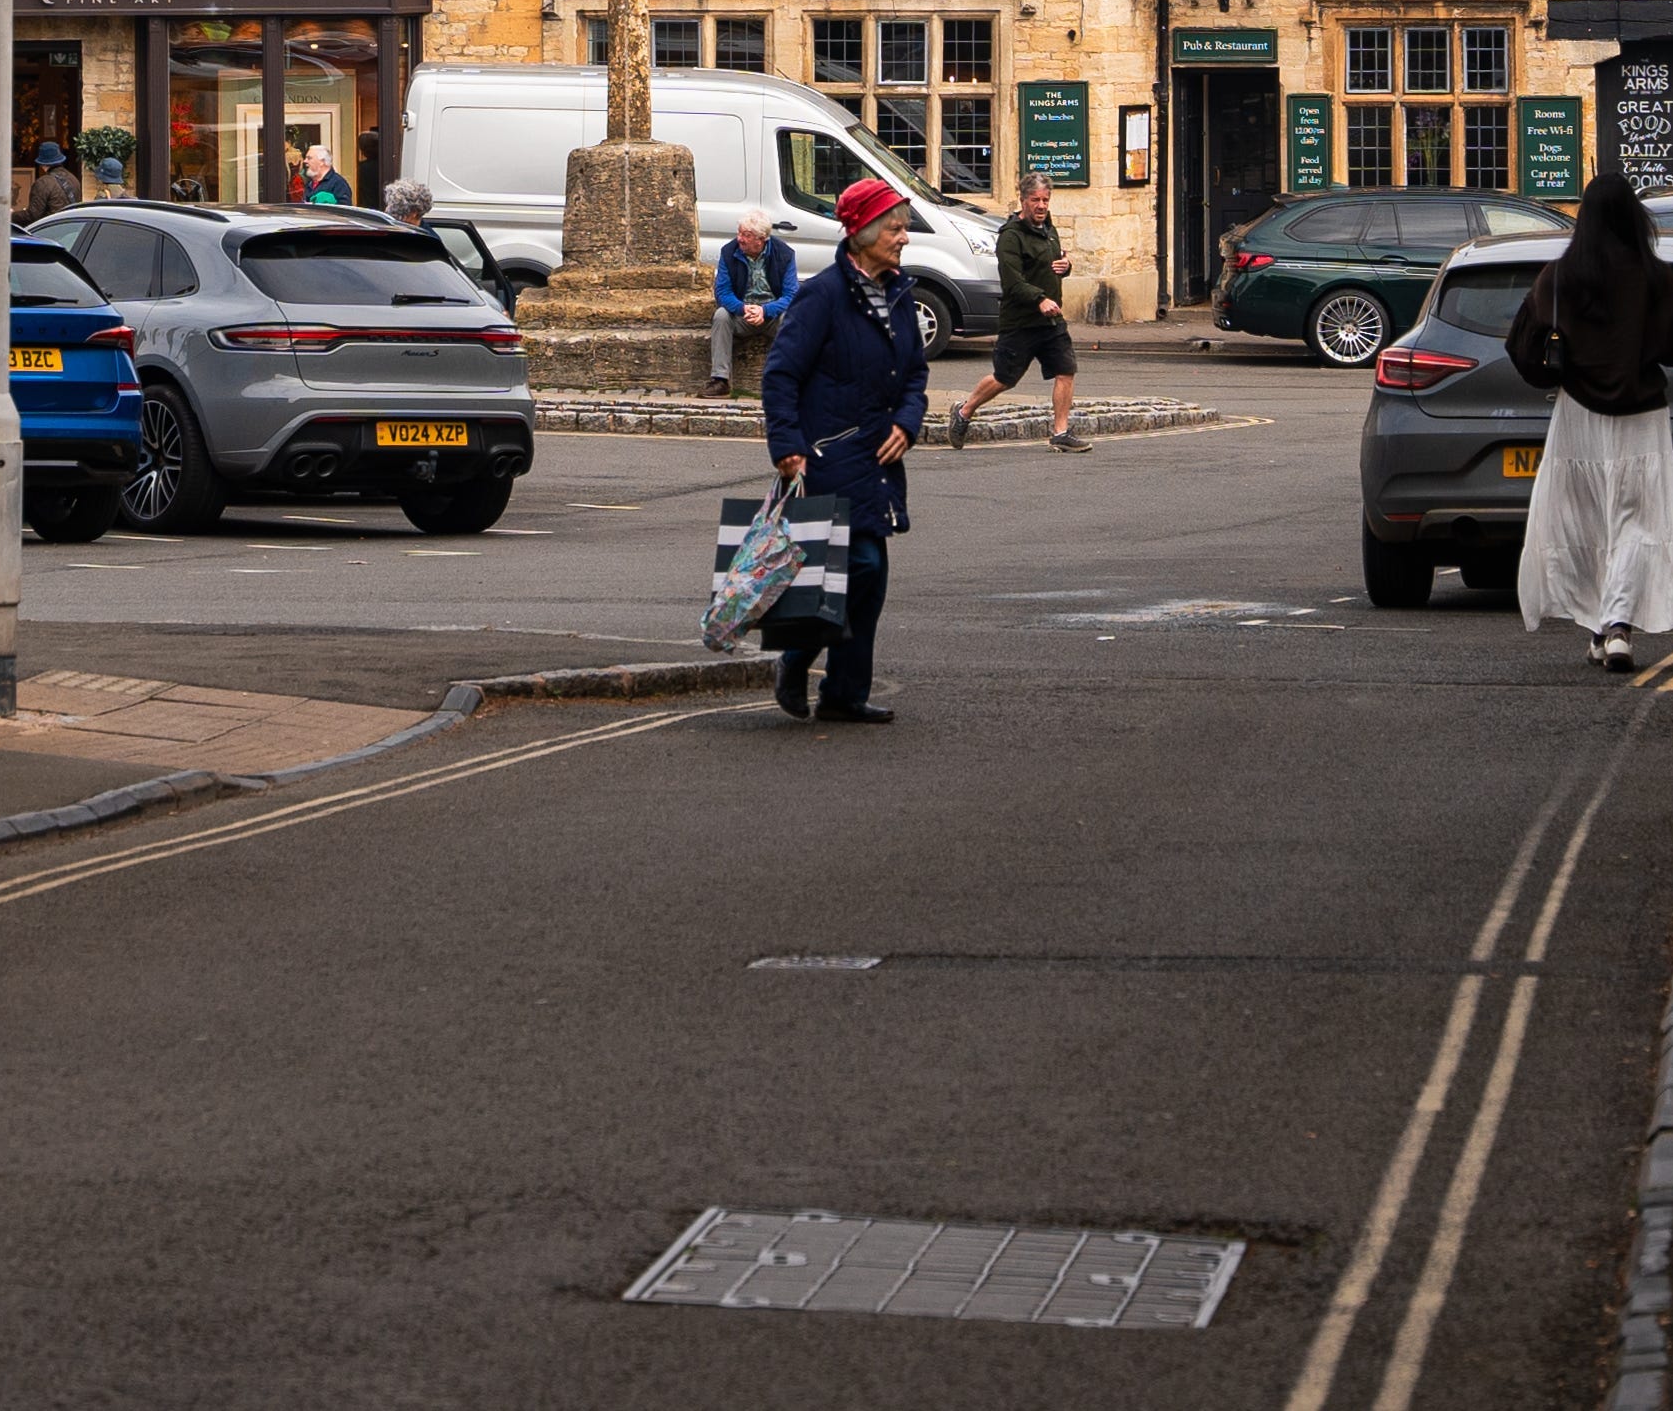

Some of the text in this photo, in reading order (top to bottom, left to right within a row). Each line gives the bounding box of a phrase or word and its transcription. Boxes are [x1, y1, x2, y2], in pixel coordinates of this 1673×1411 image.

[1183, 40, 1269, 50] Pub & Restaurant
[1621, 65, 1669, 77] KINGS
[1624, 78, 1669, 90] ARMS
[1029, 99, 1055, 107] KINGS
[1617, 101, 1673, 113] GREAT
[1299, 107, 1320, 116] Open
[1534, 109, 1566, 119] Rooms
[1527, 125, 1573, 135] Free Wi-fi
[1617, 115, 1672, 136] FOOD
[1300, 137, 1320, 146] daily
[1539, 143, 1562, 154] Dogs
[1619, 144, 1672, 157] DAILY
[1300, 156, 1320, 164] Food
[1529, 153, 1571, 162] welcome
[1297, 166, 1323, 174] served
[1530, 168, 1571, 180] Car park
[1298, 176, 1308, 184] all
[1536, 180, 1566, 188] at rear
[21, 350, 54, 368] BZC
[435, 425, 464, 442] XZP
